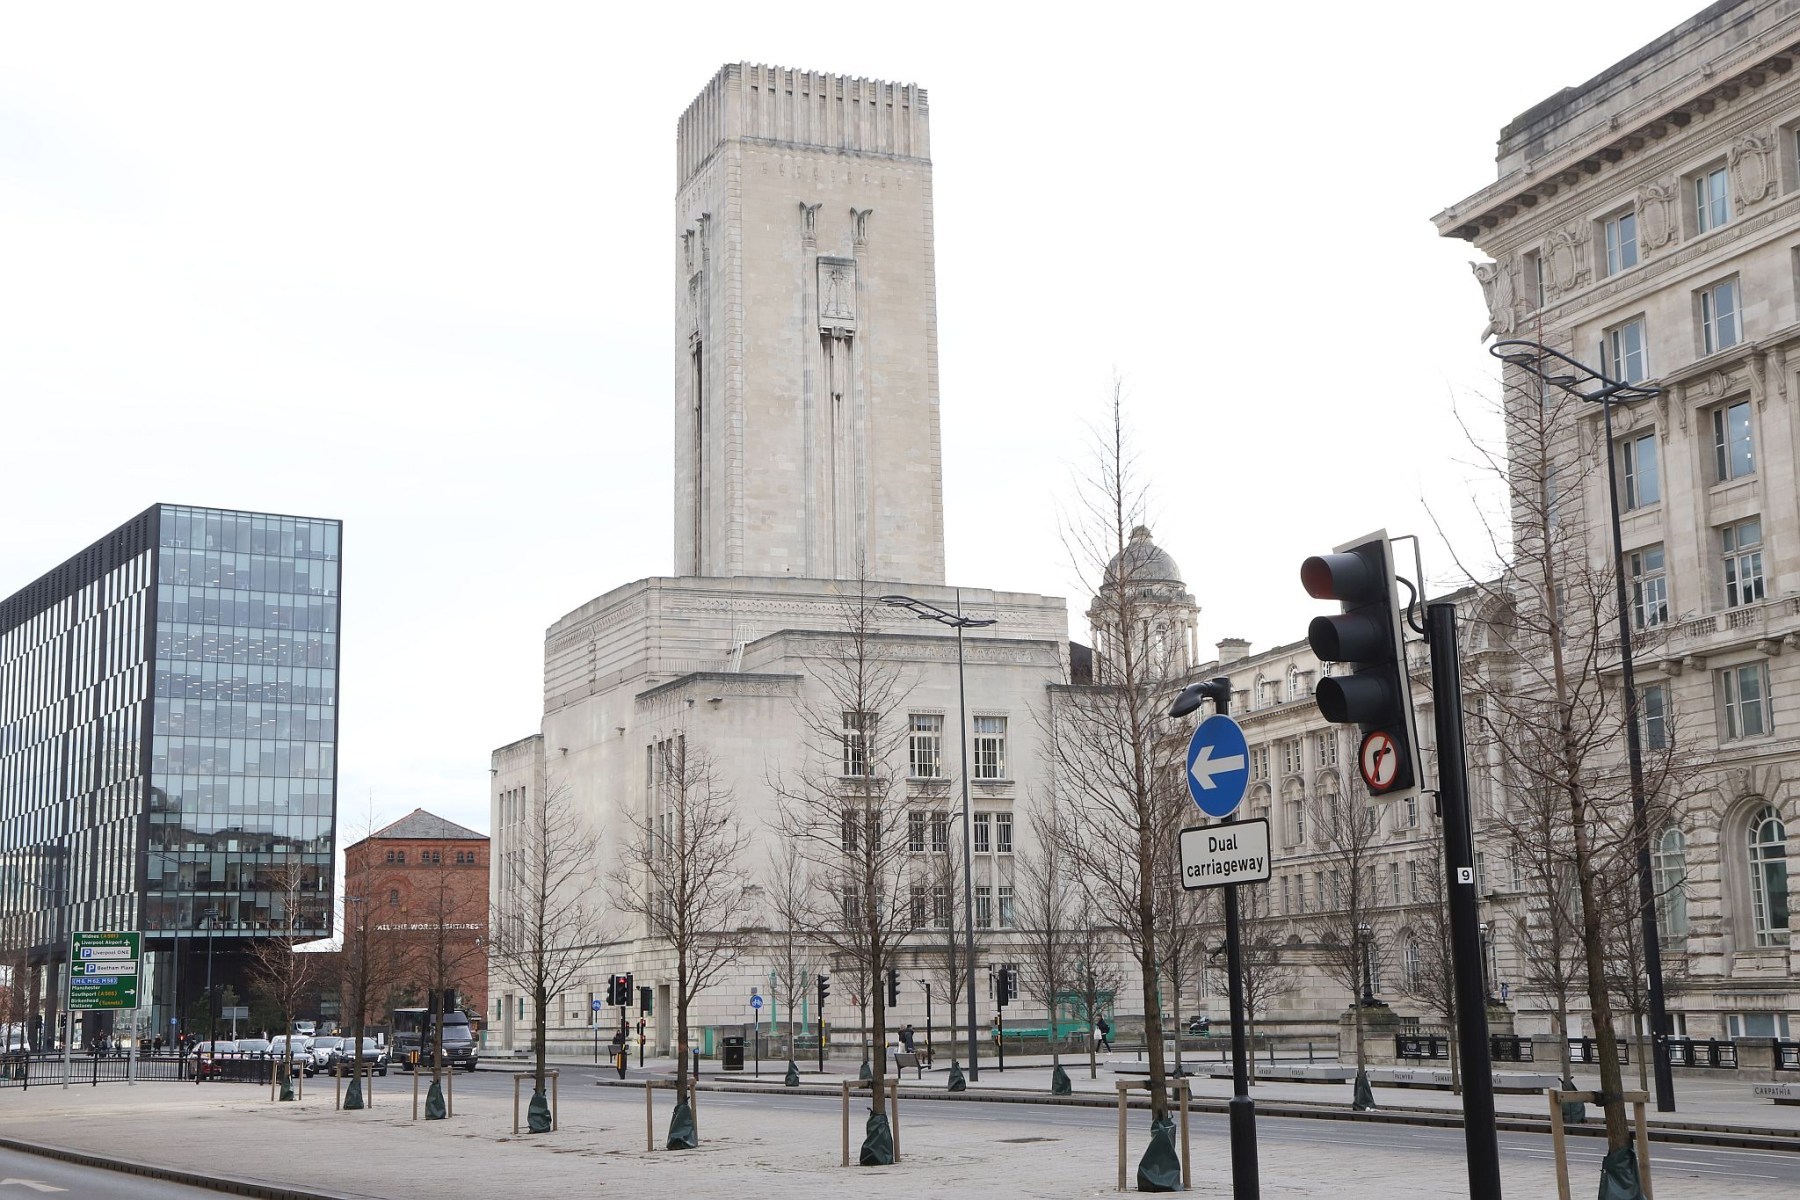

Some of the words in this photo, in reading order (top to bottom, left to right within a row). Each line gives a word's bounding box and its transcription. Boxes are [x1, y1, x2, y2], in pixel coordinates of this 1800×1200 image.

[1208, 833, 1238, 852] Dual
[1187, 856, 1264, 878] carriageway
[1461, 869, 1470, 881] 9
[83, 949, 91, 957] P
[88, 964, 95, 972] P
[1754, 1086, 1792, 1096] CARPATHIA
